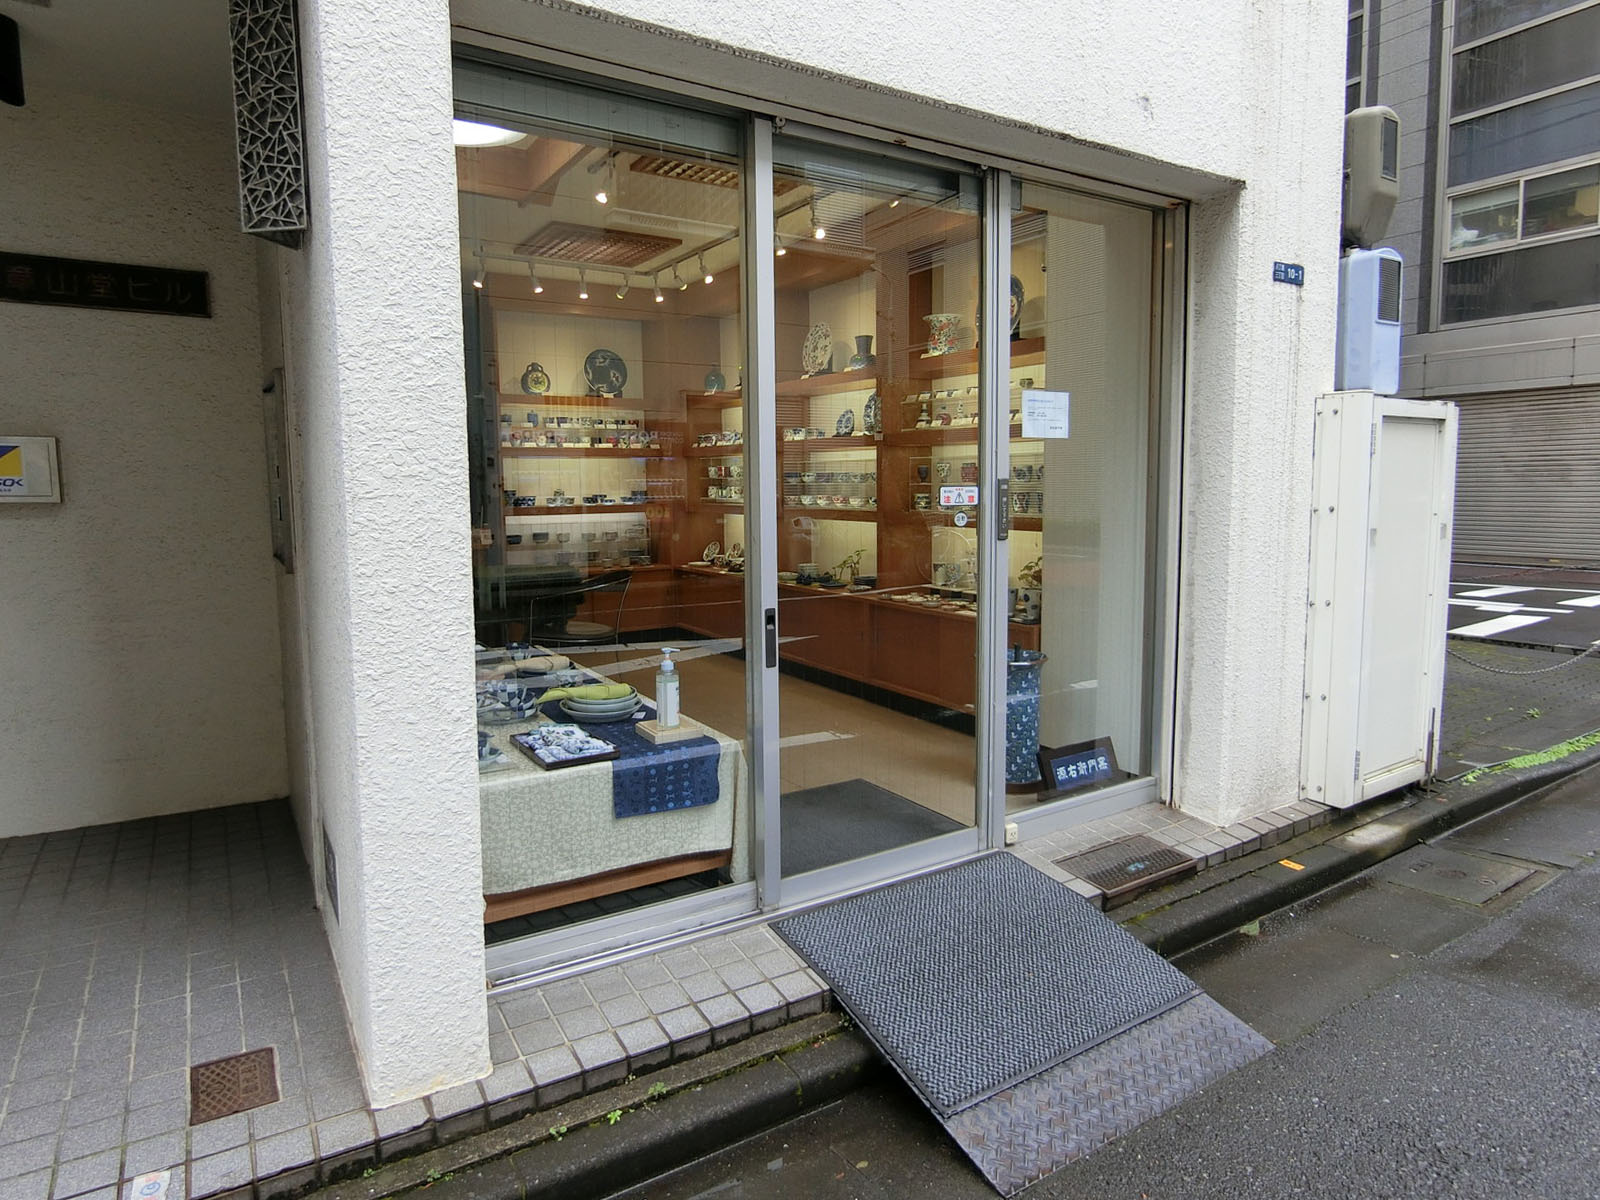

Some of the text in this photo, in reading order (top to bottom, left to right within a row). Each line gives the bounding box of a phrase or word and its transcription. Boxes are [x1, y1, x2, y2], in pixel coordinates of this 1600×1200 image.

[1288, 268, 1302, 281] 10-1
[1056, 756, 1108, 781] 源右衛門窯
